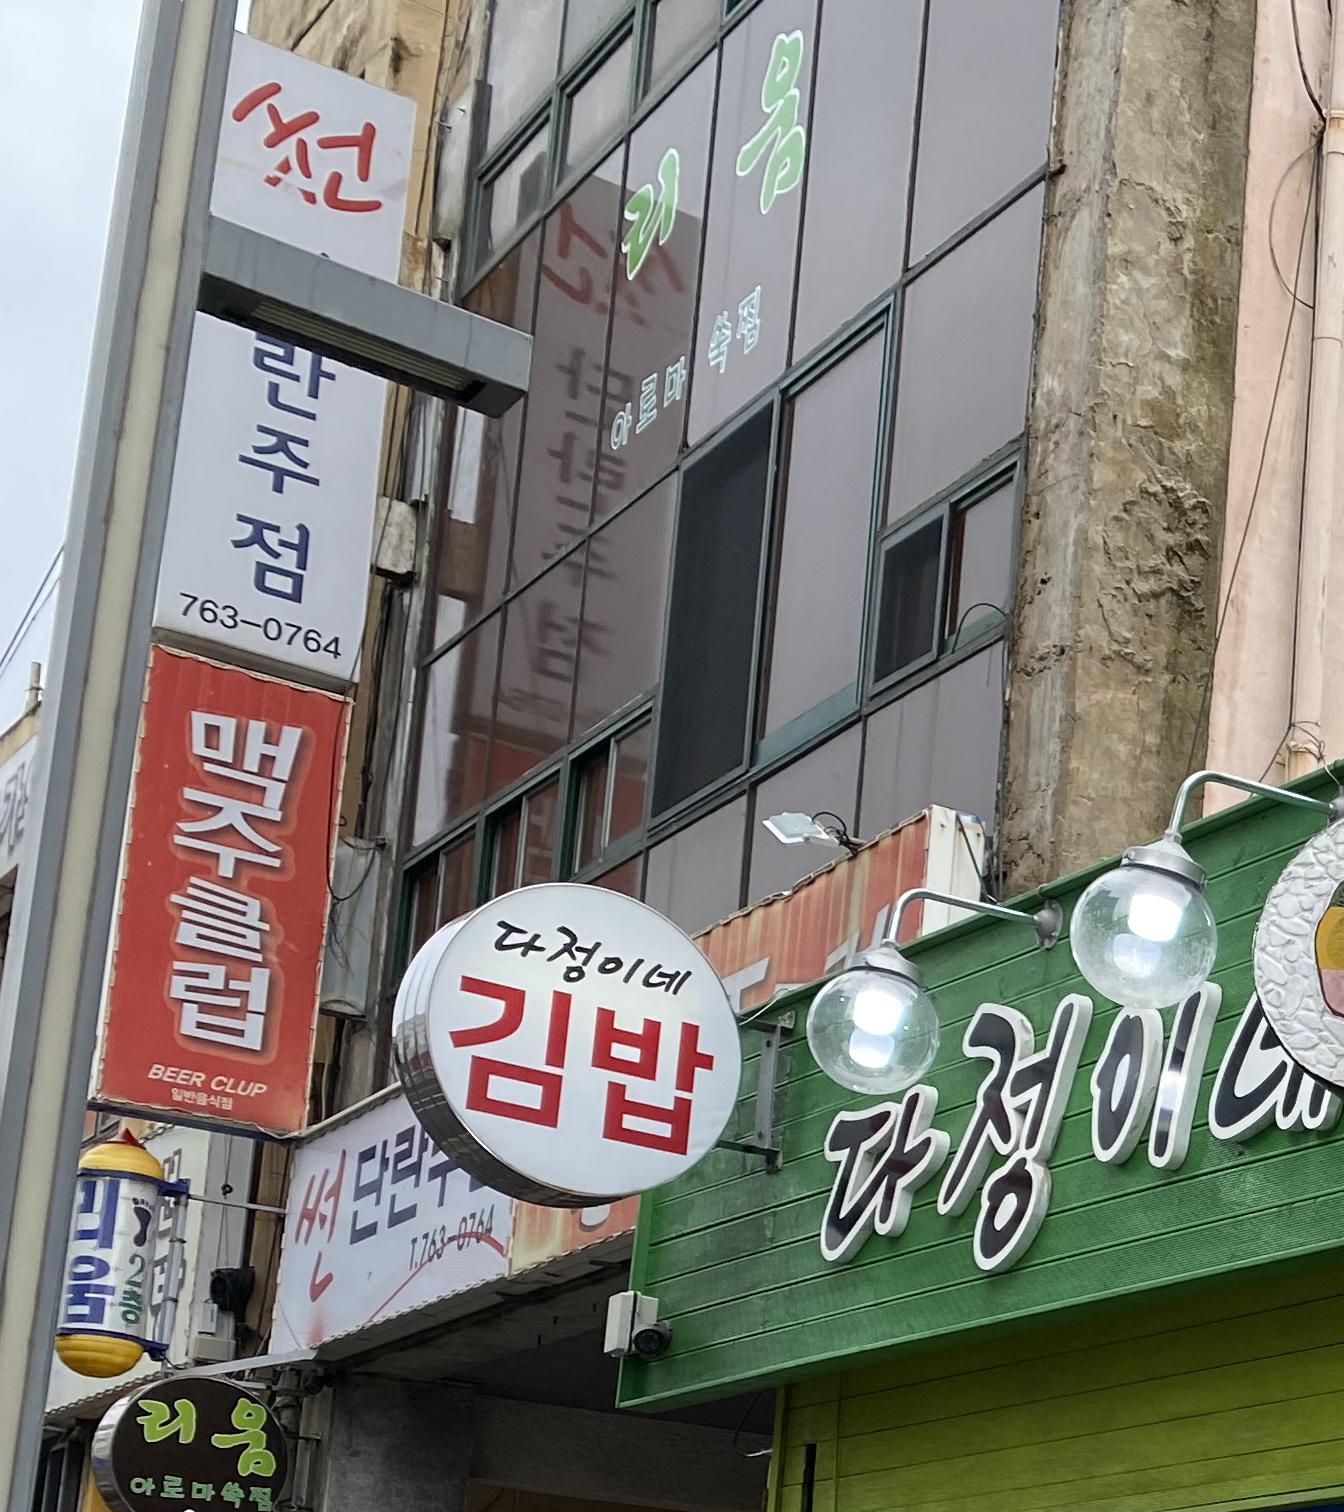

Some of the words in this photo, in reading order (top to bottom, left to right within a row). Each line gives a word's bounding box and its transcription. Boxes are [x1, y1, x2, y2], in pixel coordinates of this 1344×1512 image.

[230, 331, 337, 604] 란주점
[179, 592, 343, 660] 763-0764
[169, 710, 304, 1052] 맥주클럽
[494, 920, 692, 996] 다정이네
[147, 1064, 206, 1087] BEER
[210, 1076, 268, 1097] CLUP
[171, 1088, 233, 1110] 일반음식점
[448, 975, 715, 1156] 김밥
[350, 1125, 487, 1246] 단란주
[136, 1397, 277, 1477] 리움
